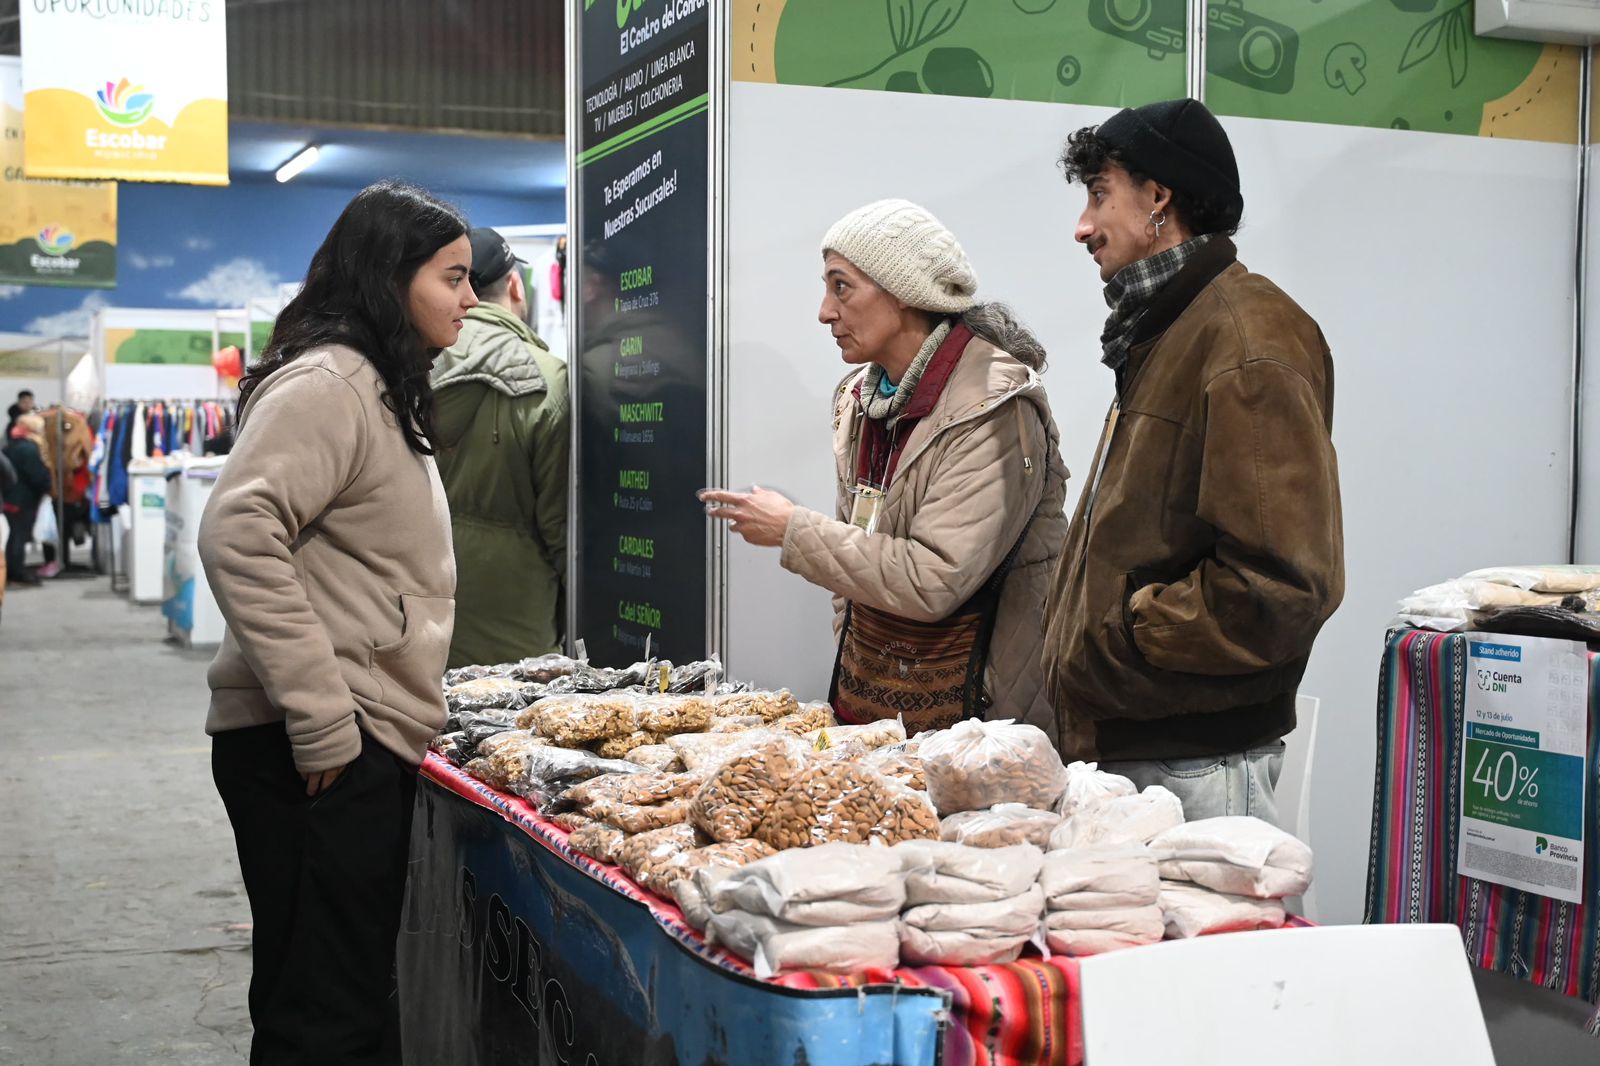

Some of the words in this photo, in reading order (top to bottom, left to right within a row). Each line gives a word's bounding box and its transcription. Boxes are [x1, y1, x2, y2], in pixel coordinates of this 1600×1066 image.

[620, 29, 629, 55] El
[629, 17, 660, 48] Centro
[661, 0, 675, 29] del
[586, 80, 618, 114] TECNOLOGÍA
[624, 69, 643, 93] AUDIO
[651, 57, 669, 78] LINEA
[669, 40, 695, 68] BLANCA
[594, 116, 602, 133] TV
[607, 99, 633, 126] MUEBLES
[640, 74, 683, 110] COLCHONERIA
[85, 128, 168, 150] Escobar
[604, 186, 612, 206] Te
[612, 158, 651, 200] Esperamos
[652, 150, 662, 170] en
[604, 206, 634, 240] Nuestras
[635, 169, 677, 219] Sucursales!
[620, 266, 653, 291] ESCOBAR
[620, 335, 643, 357] GARIN
[620, 402, 664, 423] MASCHWITZ
[619, 470, 649, 490] MATHEU
[619, 535, 654, 559] CARDALES
[636, 602, 661, 629] SEÑOR
[1479, 646, 1495, 655] Stand
[1495, 647, 1519, 658] adherido
[1492, 671, 1522, 684] Cuenta
[1492, 683, 1507, 693] DNI
[1486, 711, 1492, 719] 13
[1493, 712, 1500, 720] de
[1500, 712, 1513, 722] julio
[1475, 727, 1495, 737] Mercado
[1495, 730, 1501, 738] de
[1501, 731, 1536, 743] Oportunidades
[1549, 850, 1578, 862] Provincia
[1550, 843, 1568, 853] Banco
[486, 893, 600, 1066] SEC
